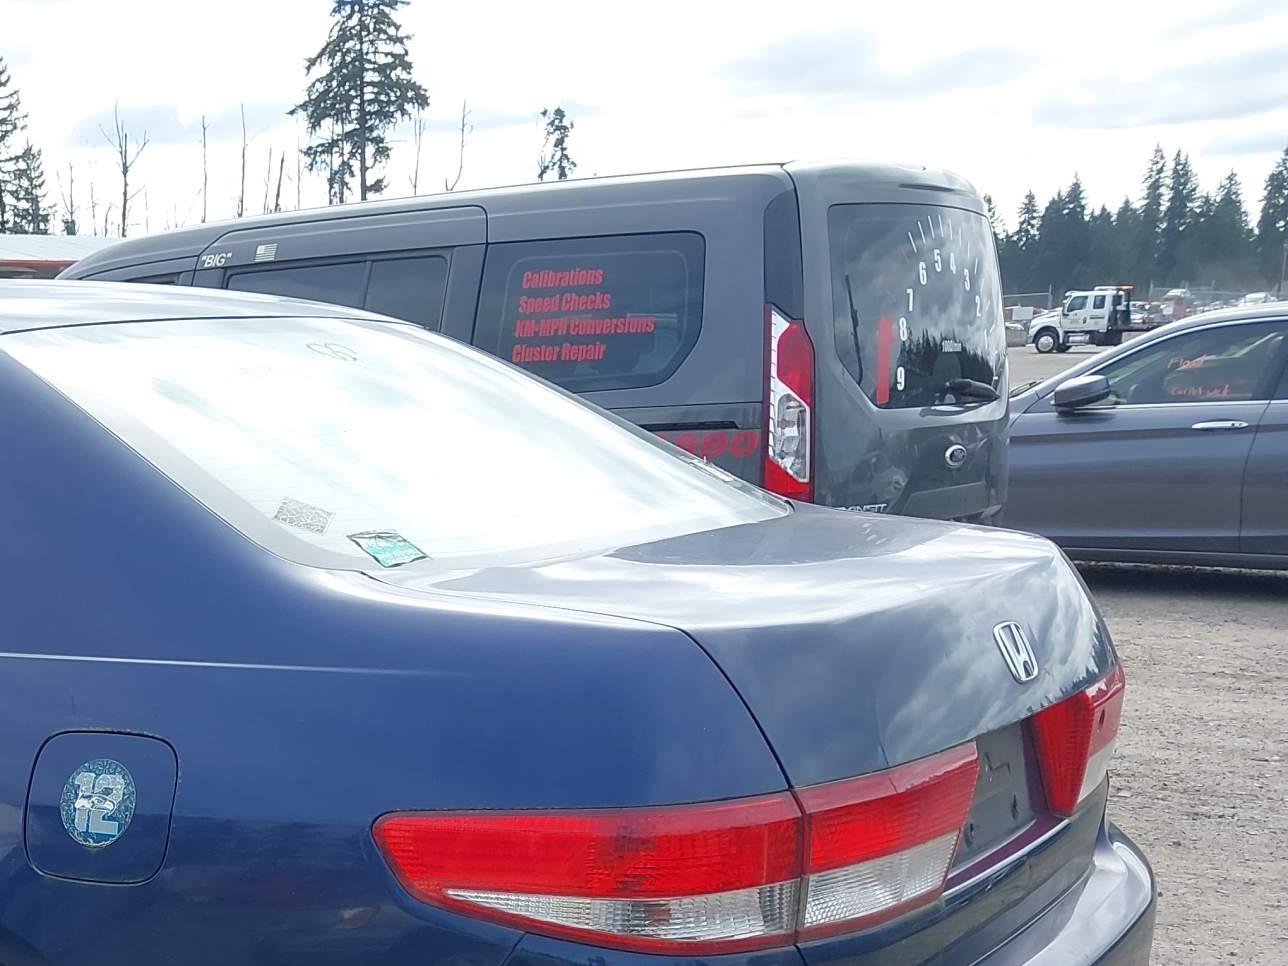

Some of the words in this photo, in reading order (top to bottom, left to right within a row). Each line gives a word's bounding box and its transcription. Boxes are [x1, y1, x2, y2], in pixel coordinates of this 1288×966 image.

[201, 252, 232, 268] "BIG"
[933, 249, 942, 273] 5
[949, 252, 956, 275] 4
[522, 268, 604, 289] Calibrations
[918, 261, 928, 286] 6
[963, 268, 971, 292] 3
[518, 294, 561, 314] Speed
[561, 291, 611, 311] Checks
[906, 288, 915, 312] 7
[975, 295, 982, 318] 2
[515, 318, 568, 338] KM-MPH
[569, 315, 656, 335] Conversions
[899, 317, 908, 342] 8
[512, 343, 560, 363] Cluster
[561, 341, 607, 361] Repair
[896, 366, 906, 391] 9
